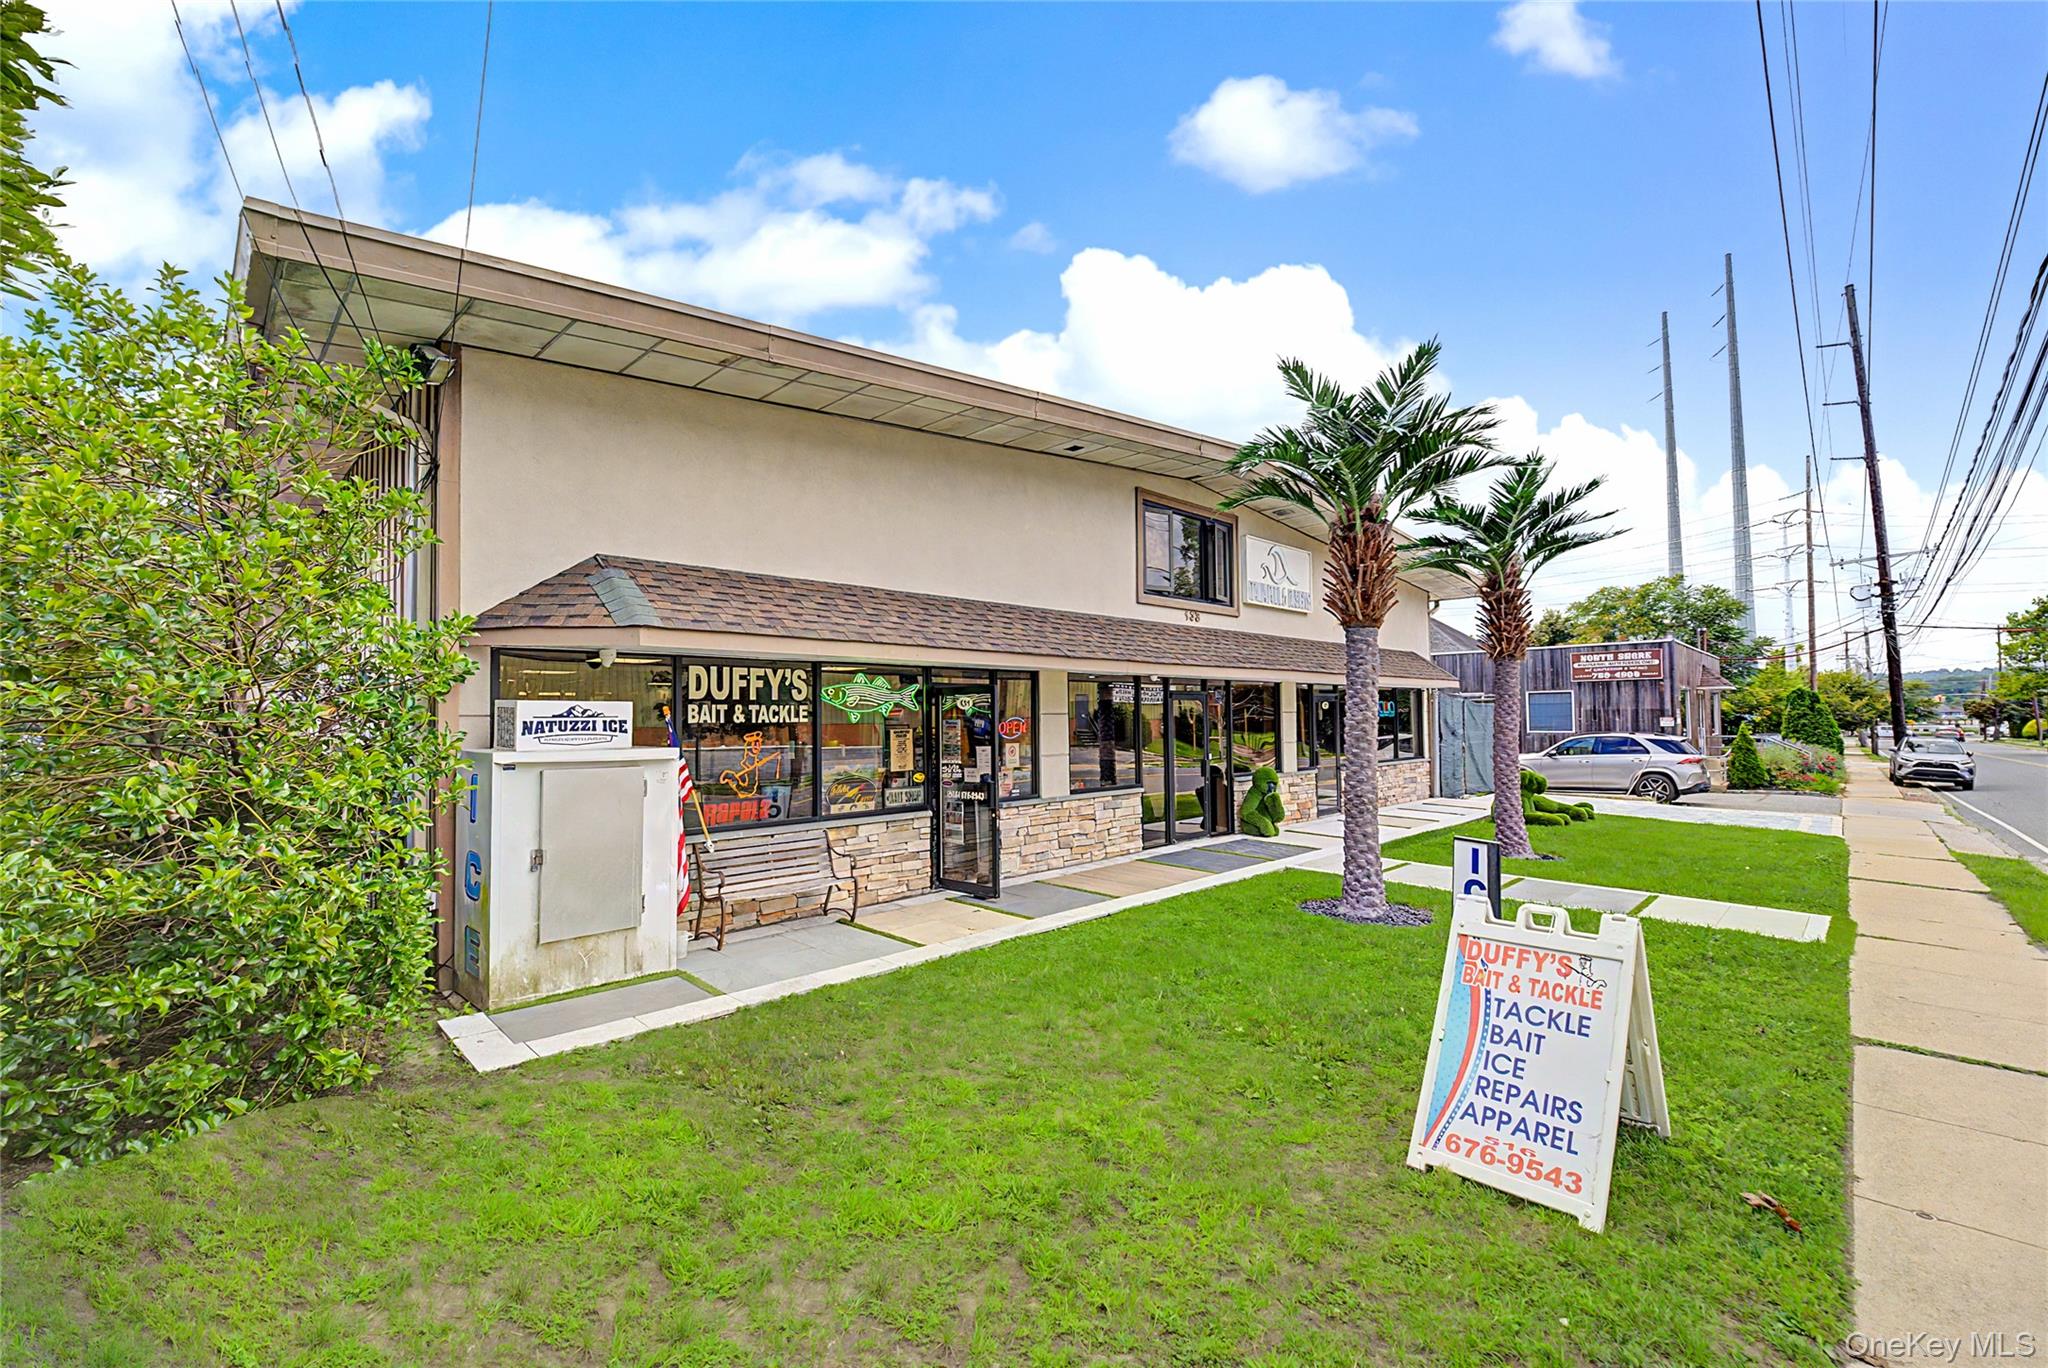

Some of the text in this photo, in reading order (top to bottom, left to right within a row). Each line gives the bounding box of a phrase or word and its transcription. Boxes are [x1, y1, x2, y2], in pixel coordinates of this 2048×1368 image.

[688, 665, 808, 701] DUFFY'S
[521, 719, 629, 736] NATUZZI ICE
[687, 704, 809, 723] BAIT & TACKLE
[998, 720, 1027, 735] OPEN
[465, 773, 482, 978] ICE
[1464, 847, 1487, 895] IC
[1466, 941, 1573, 979] DUFFY'S
[1463, 964, 1604, 1010] BAIT & TACKLE
[1494, 998, 1592, 1038] TACKLE
[1490, 1024, 1546, 1055] BAIT
[1483, 1050, 1526, 1080] ICE
[1475, 1075, 1583, 1124] REPAIRS
[1459, 1102, 1579, 1156] APPAREL
[1484, 1135, 1537, 1158] 516
[1445, 1133, 1583, 1195] 676-9543
